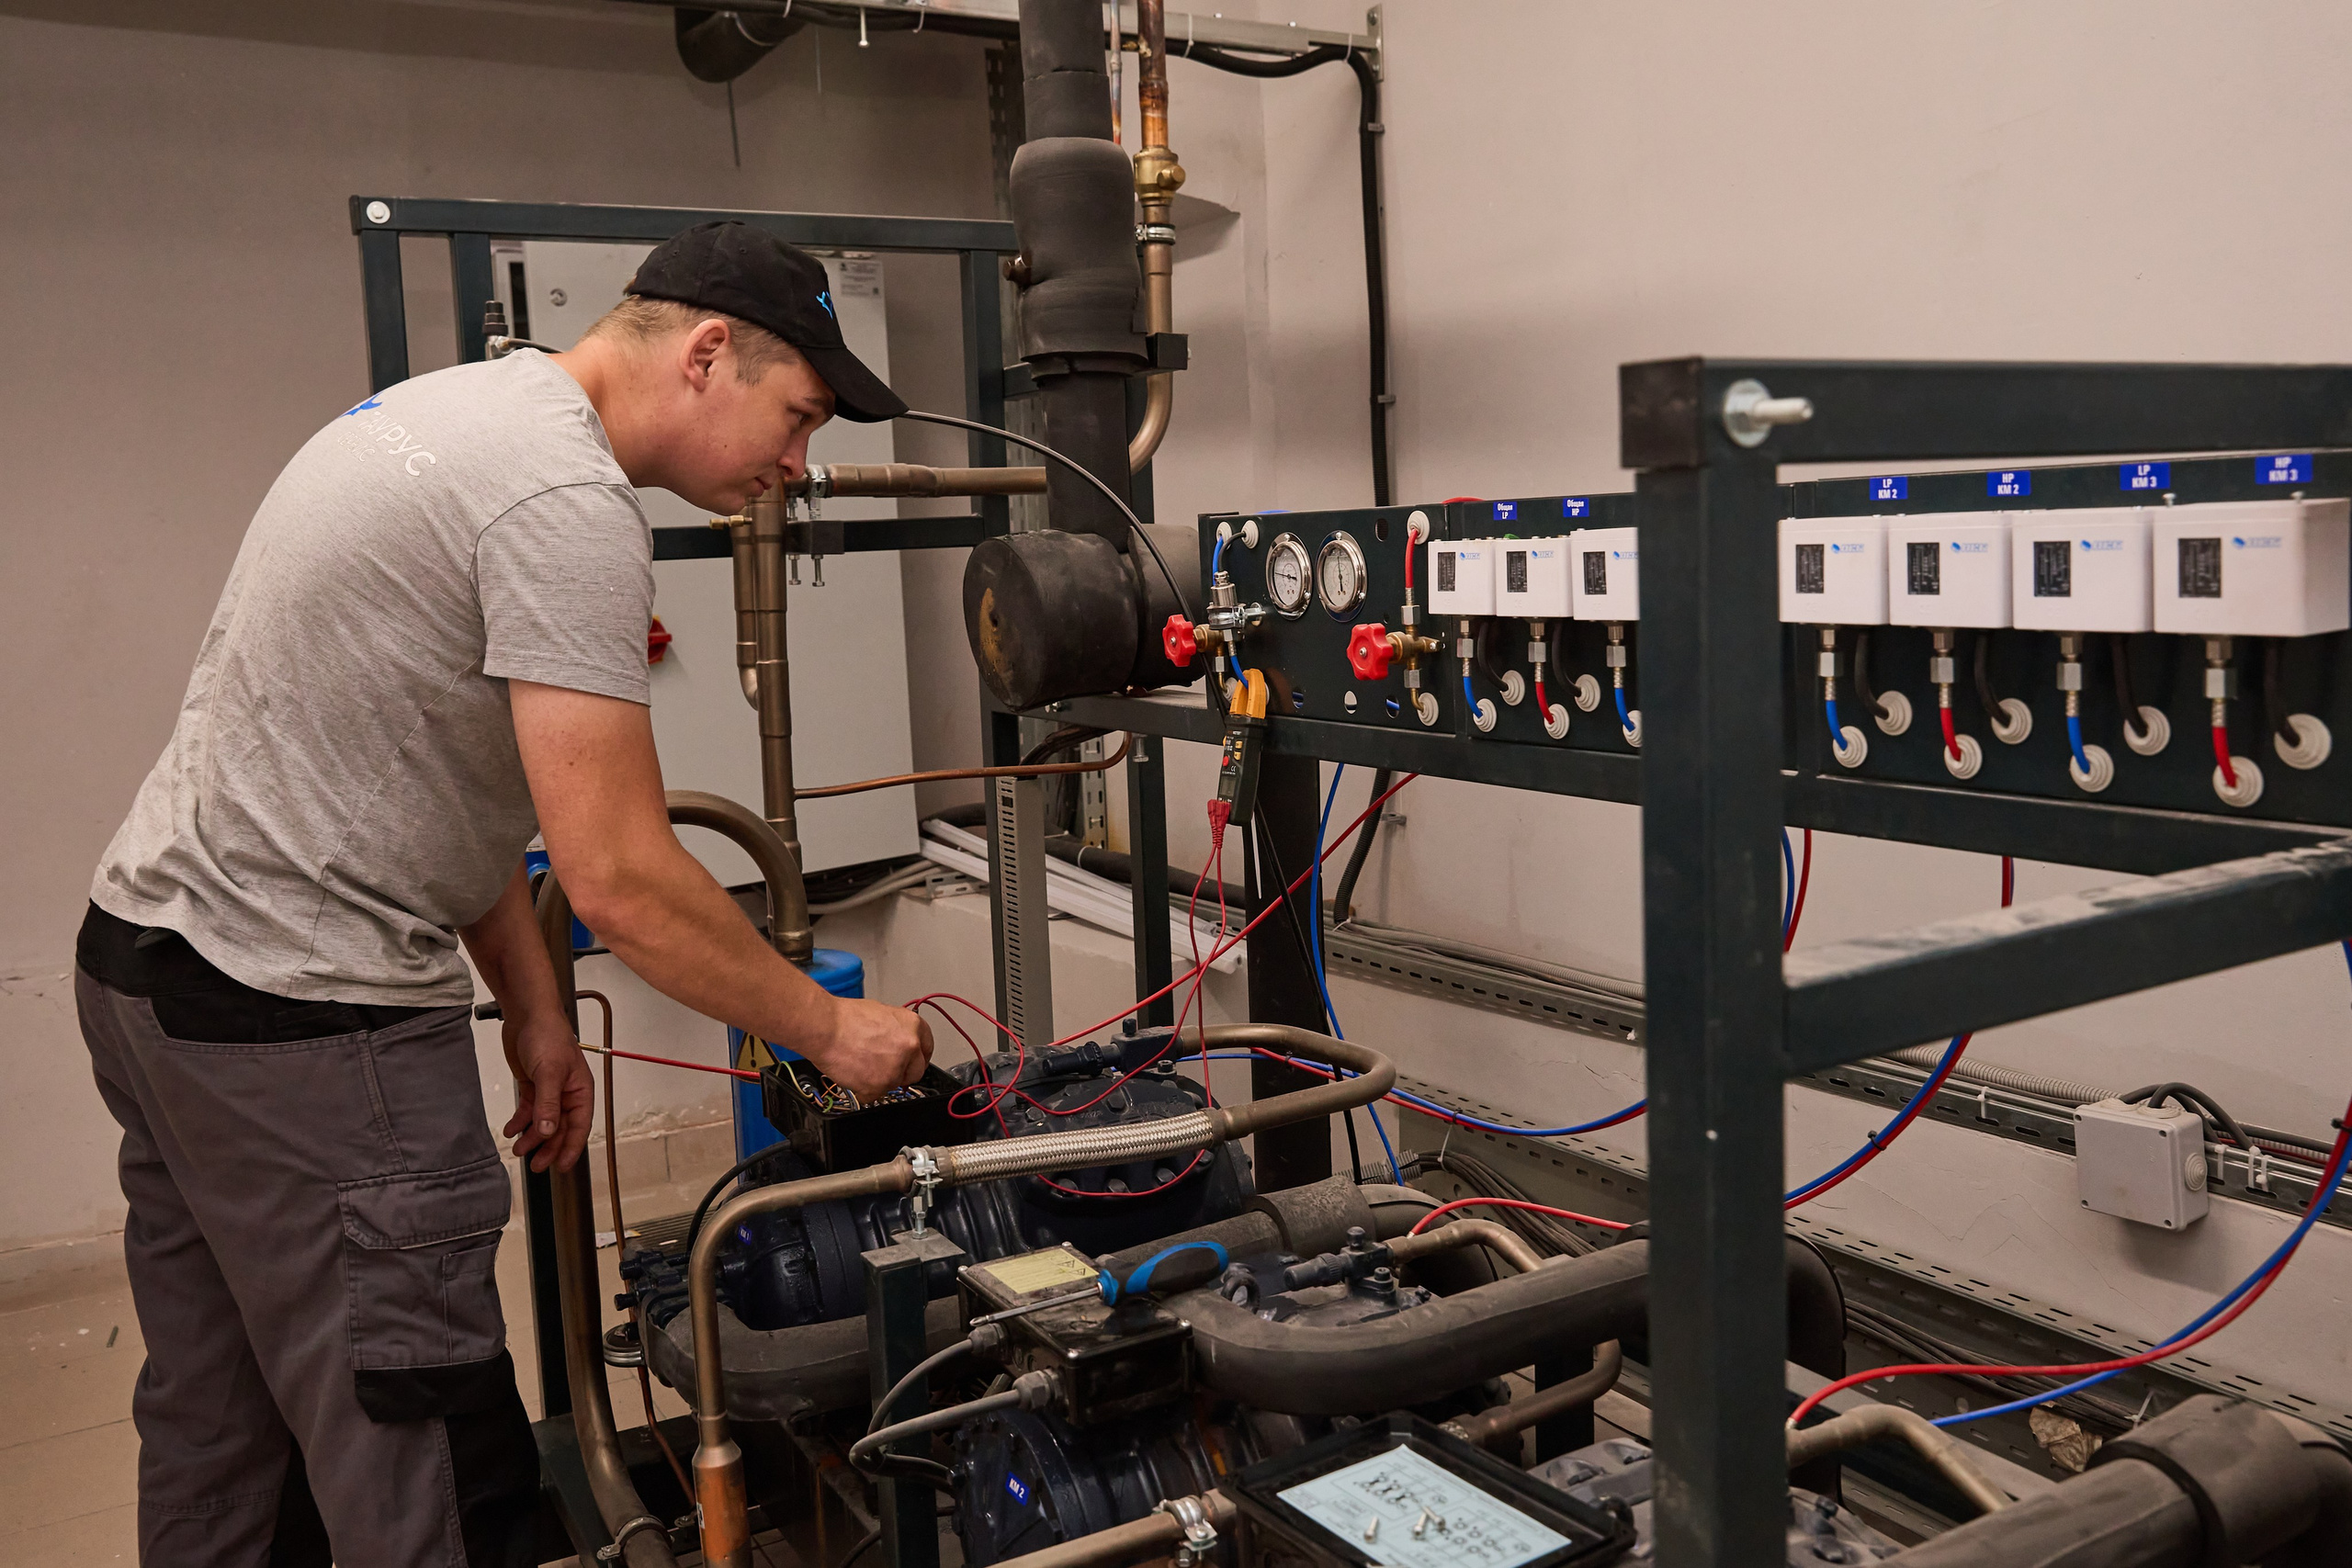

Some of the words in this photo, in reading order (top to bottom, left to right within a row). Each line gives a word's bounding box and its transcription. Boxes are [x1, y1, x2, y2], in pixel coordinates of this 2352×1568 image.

[2275, 457, 2292, 468] HP
[2138, 465, 2151, 476] LP
[2290, 468, 2299, 481] 3
[2002, 473, 2015, 483] HP
[2150, 476, 2157, 488] 3
[1883, 479, 1894, 489] LP
[2013, 484, 2019, 494] 2
[1892, 489, 1897, 499] 2
[1502, 511, 1509, 520] LP
[1019, 1487, 1025, 1499] 2
